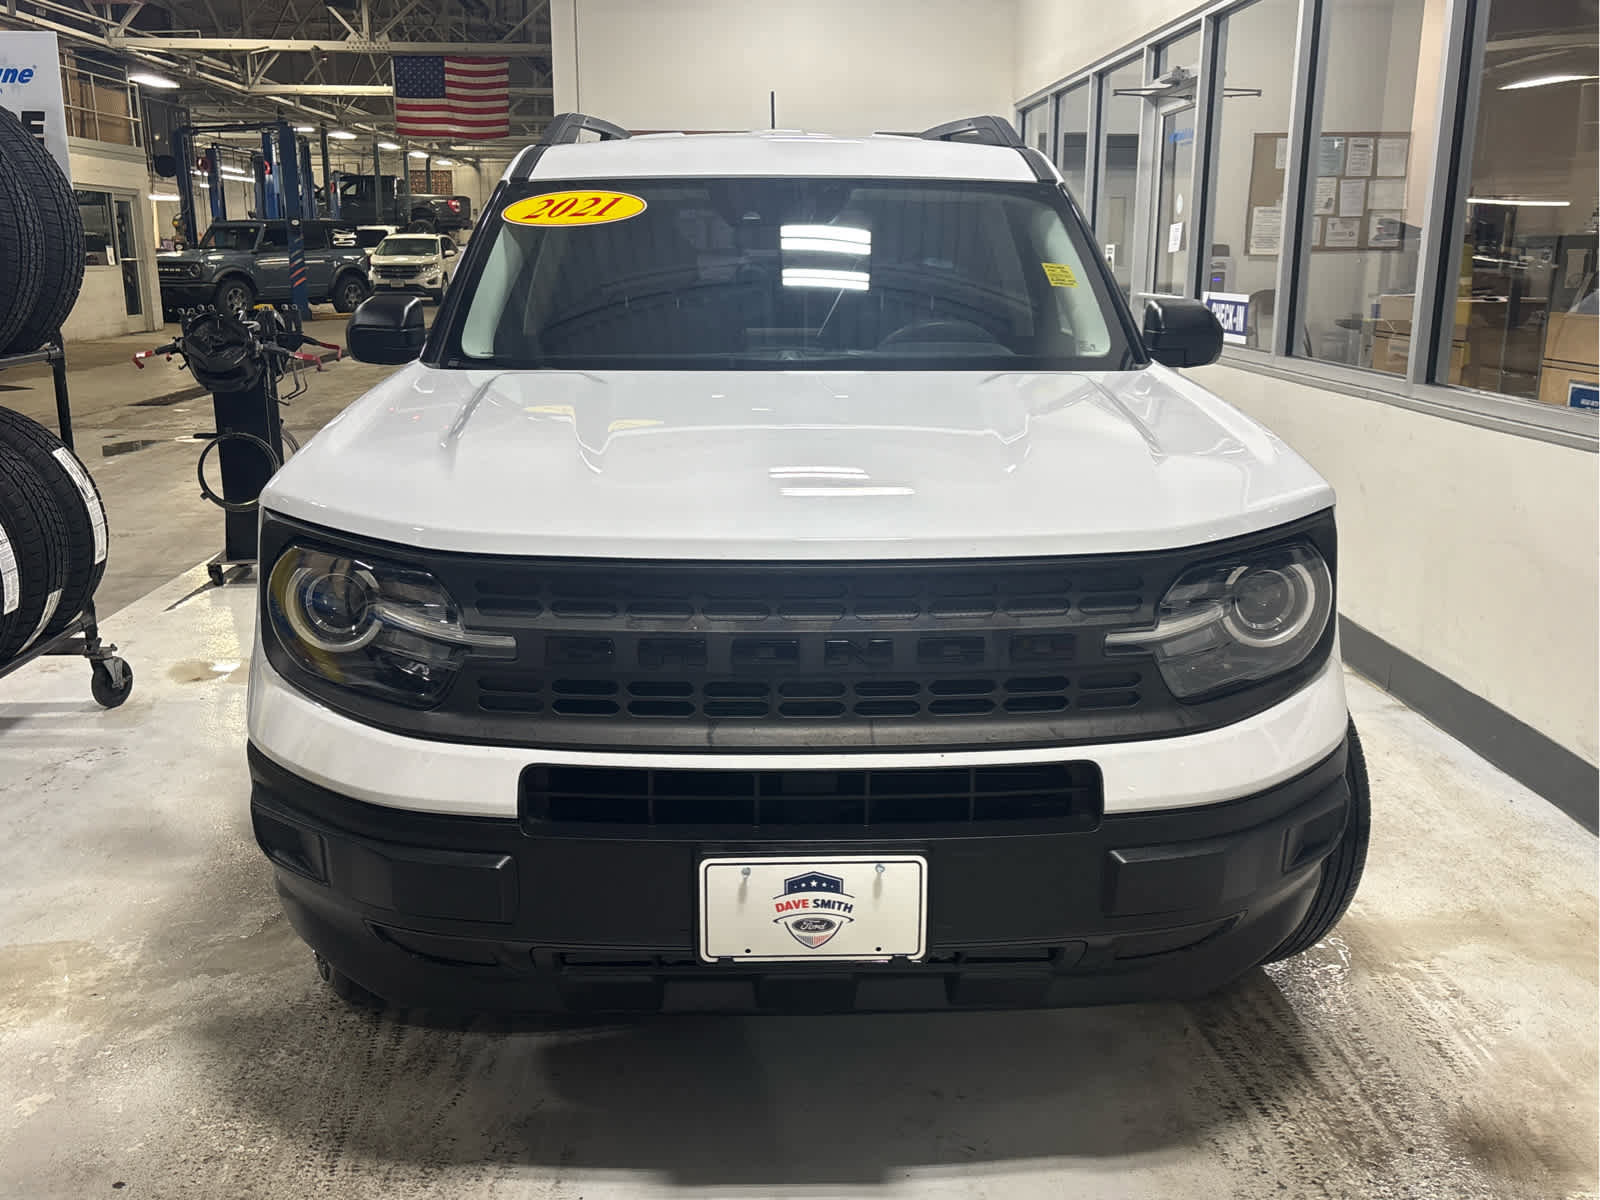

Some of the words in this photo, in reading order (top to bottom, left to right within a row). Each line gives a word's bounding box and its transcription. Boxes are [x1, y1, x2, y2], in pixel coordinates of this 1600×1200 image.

[522, 197, 624, 219] 2021
[775, 899, 809, 912] DAVE
[812, 899, 853, 913] SMITH
[800, 920, 828, 930] Ford
